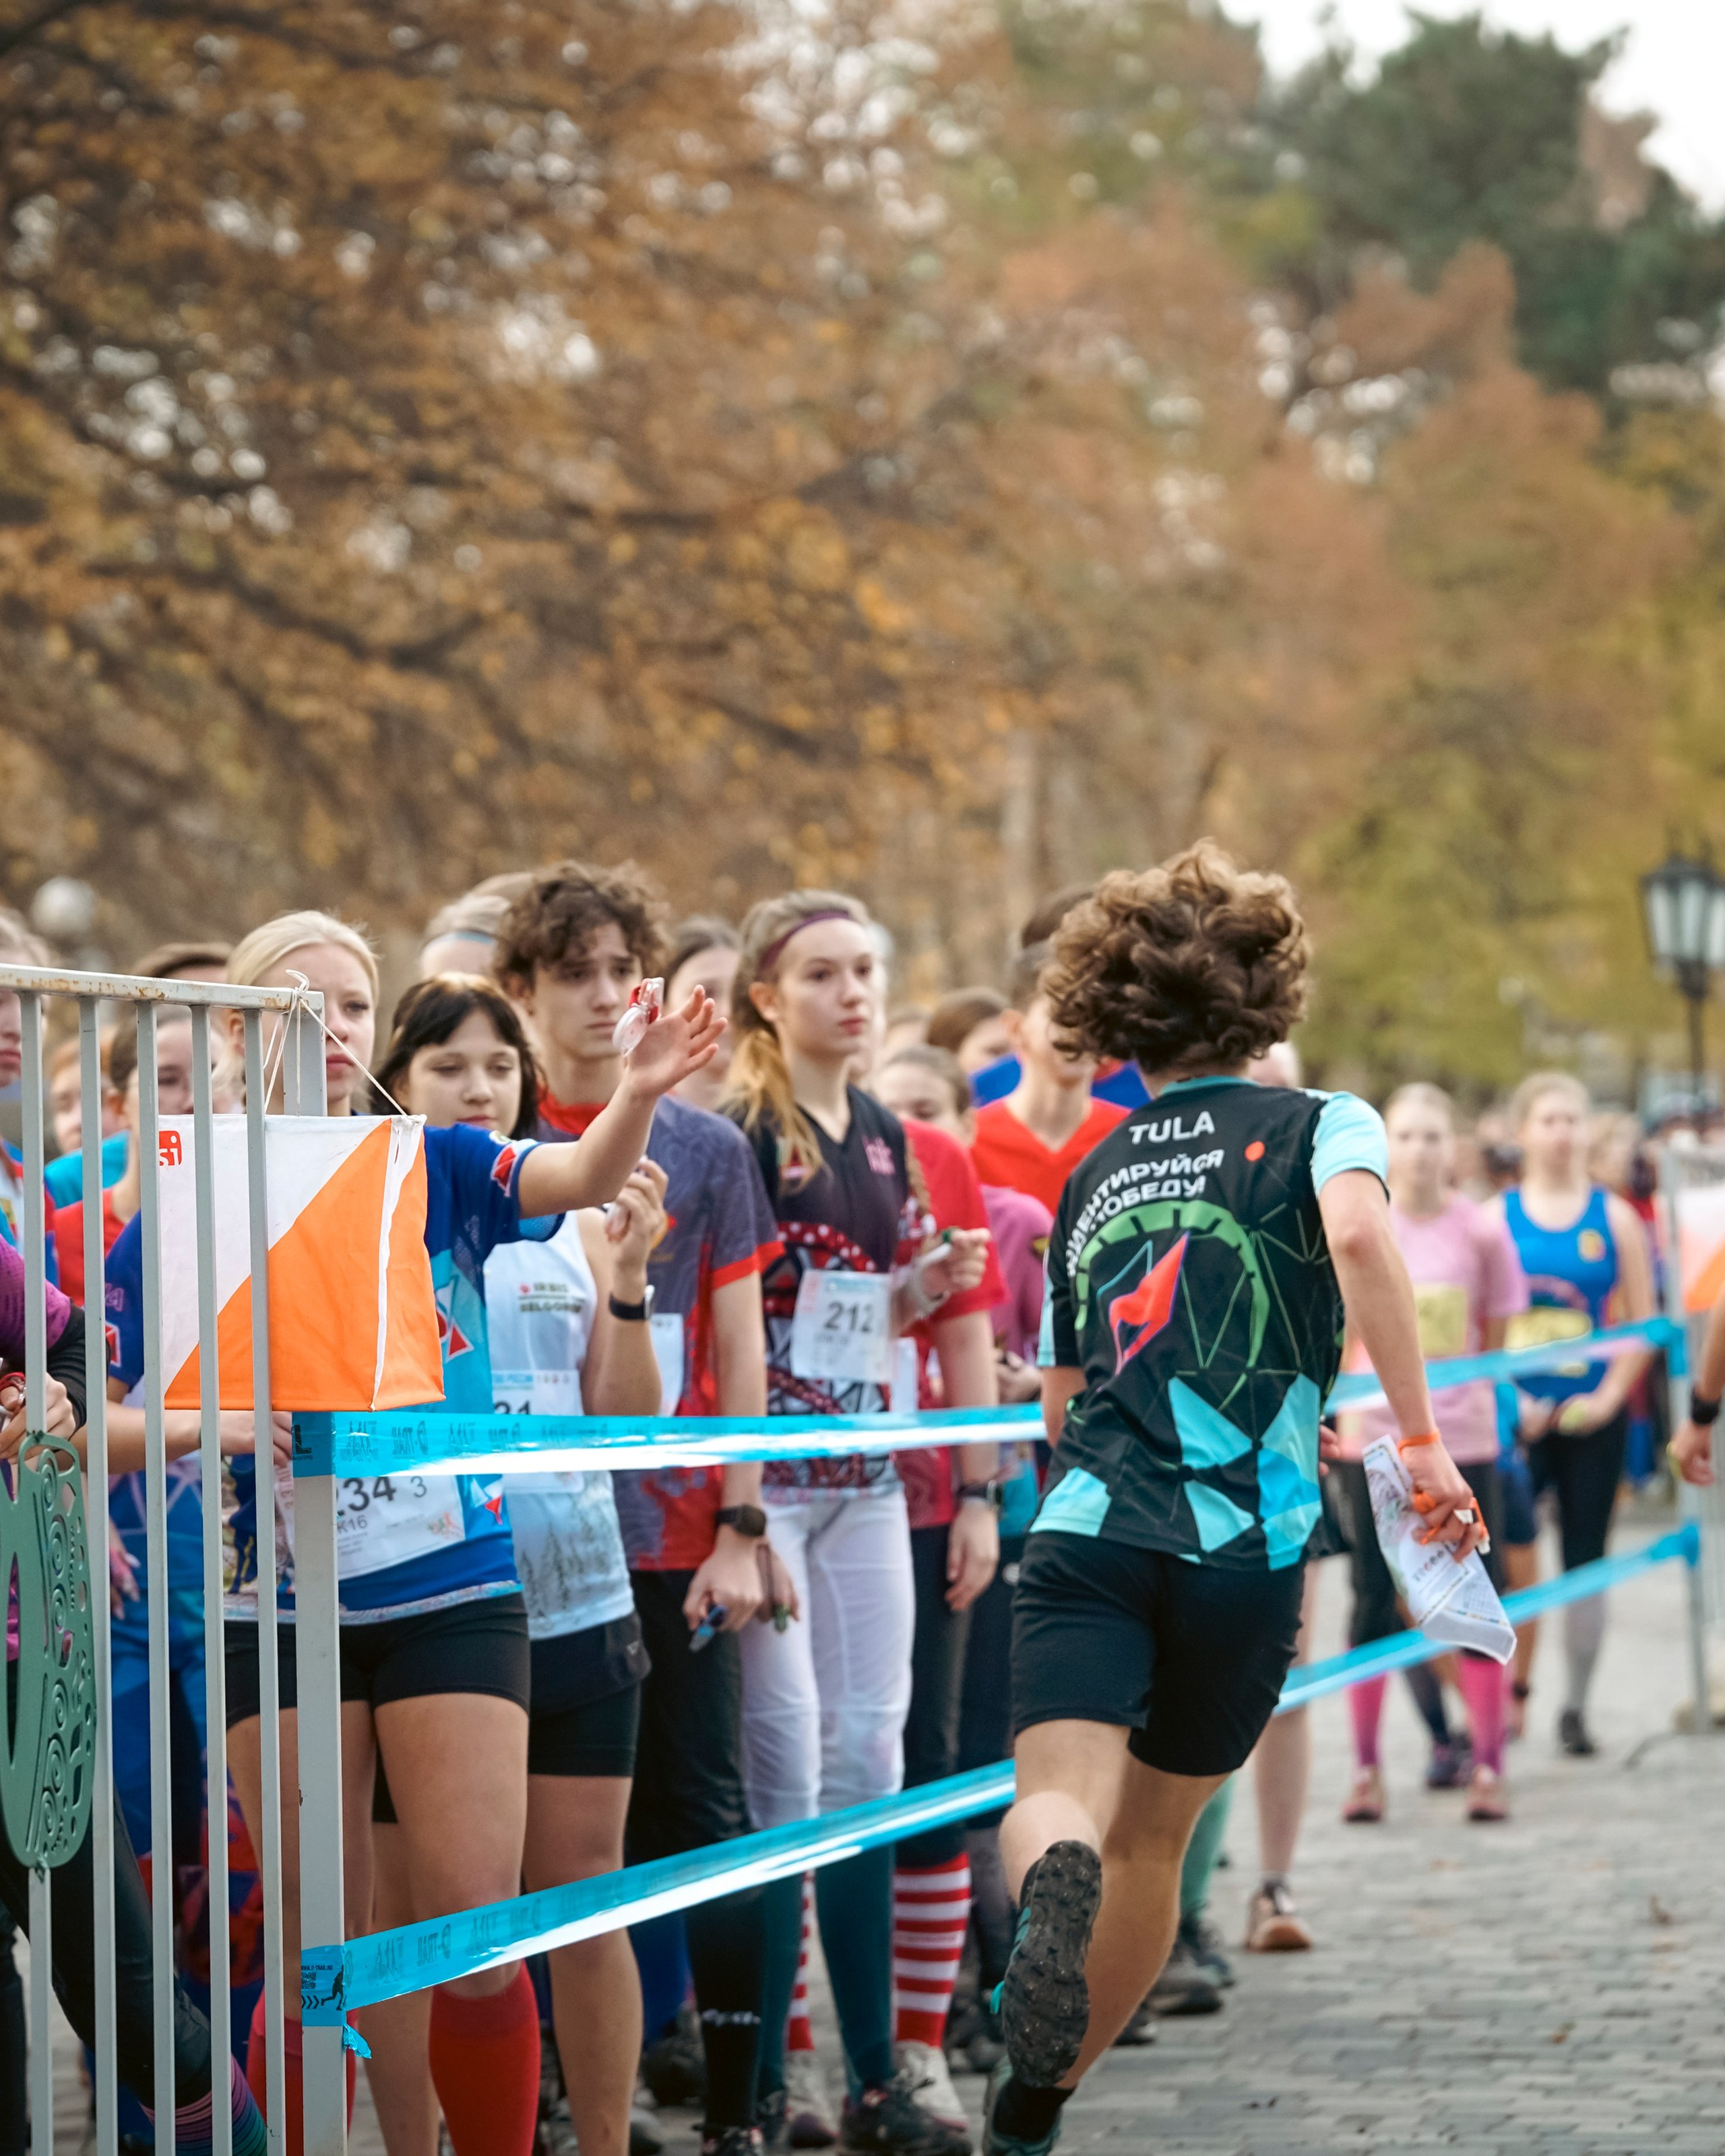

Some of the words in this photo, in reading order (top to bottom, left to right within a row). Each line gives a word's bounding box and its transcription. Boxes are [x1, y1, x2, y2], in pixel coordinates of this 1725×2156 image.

[1129, 1111, 1216, 1144] TULA
[336, 1477, 396, 1516] 34
[410, 1476, 427, 1498] 3
